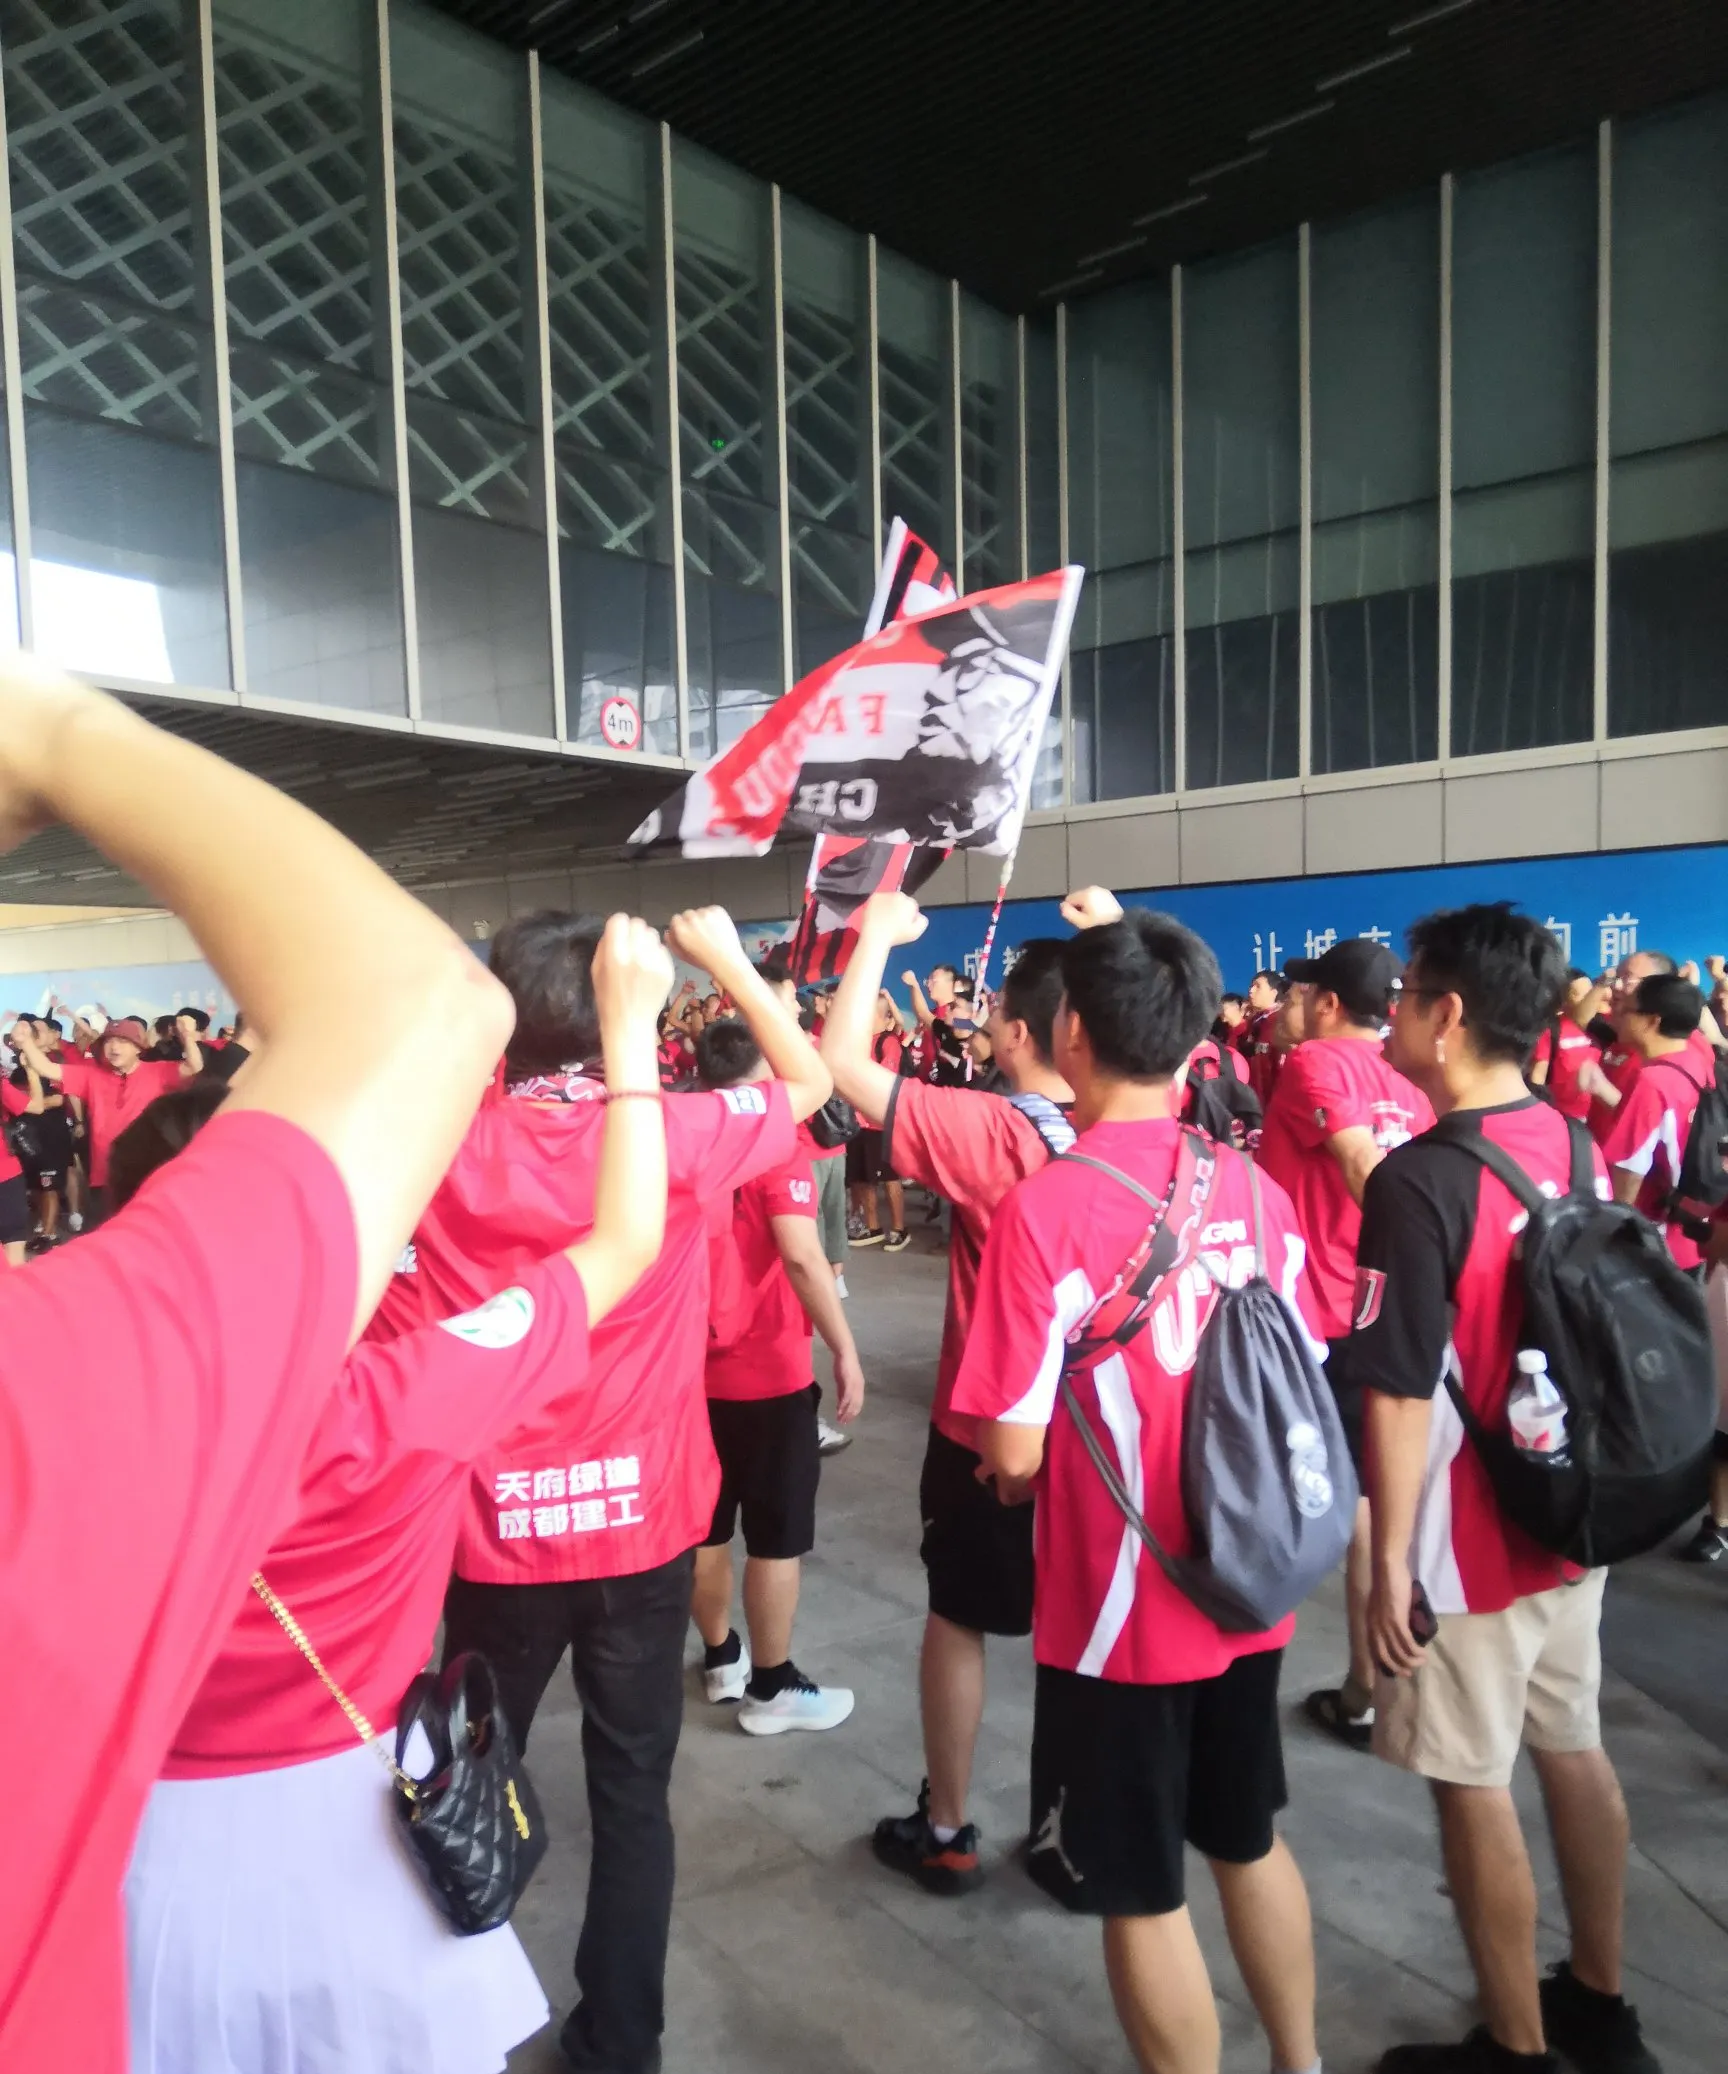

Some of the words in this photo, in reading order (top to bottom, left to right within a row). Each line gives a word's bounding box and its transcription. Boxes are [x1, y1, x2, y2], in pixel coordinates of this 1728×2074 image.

[494, 1455, 640, 1504] 天府绿道
[497, 1492, 645, 1540] 成都建工
